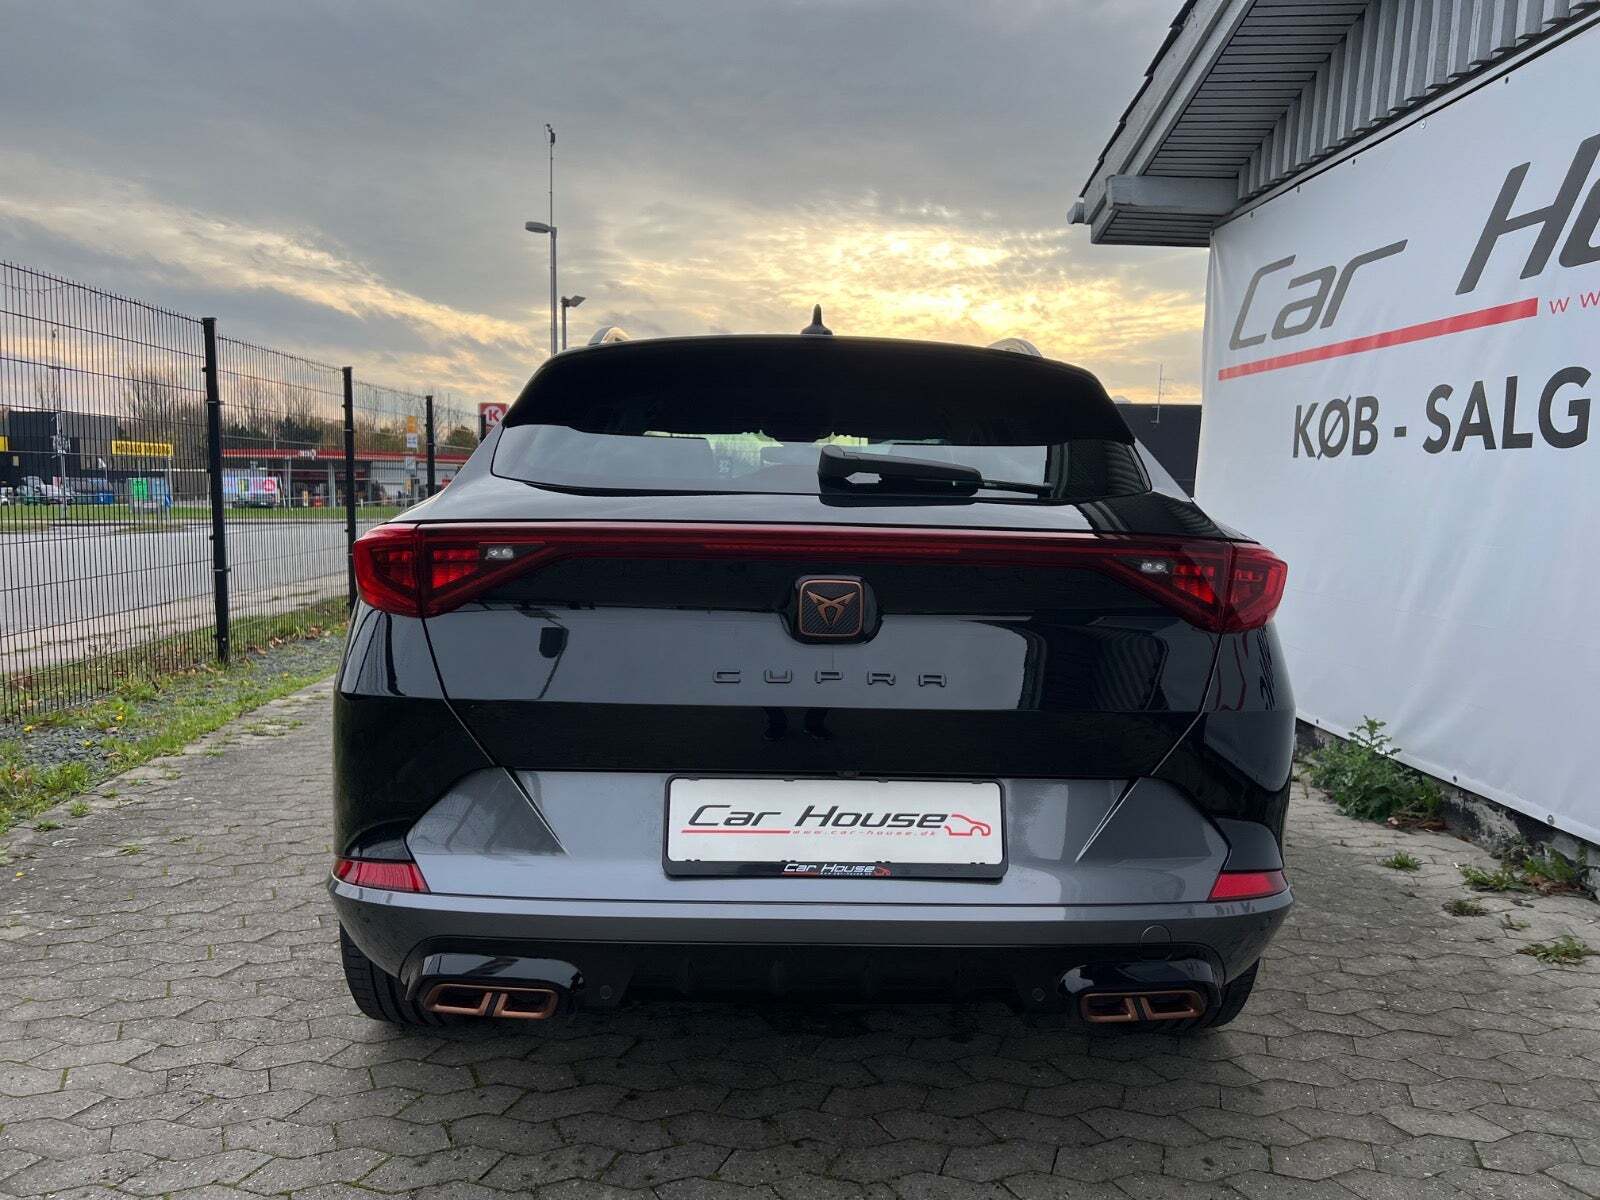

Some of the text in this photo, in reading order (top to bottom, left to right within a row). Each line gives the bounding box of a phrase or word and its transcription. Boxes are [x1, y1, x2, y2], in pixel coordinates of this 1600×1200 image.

[1228, 239, 1408, 351] Car
[1292, 394, 1379, 460] KØB
[1422, 365, 1592, 454] SALG
[712, 668, 948, 688] CUPRA
[688, 804, 949, 829] Car House
[783, 863, 876, 873] Car House
